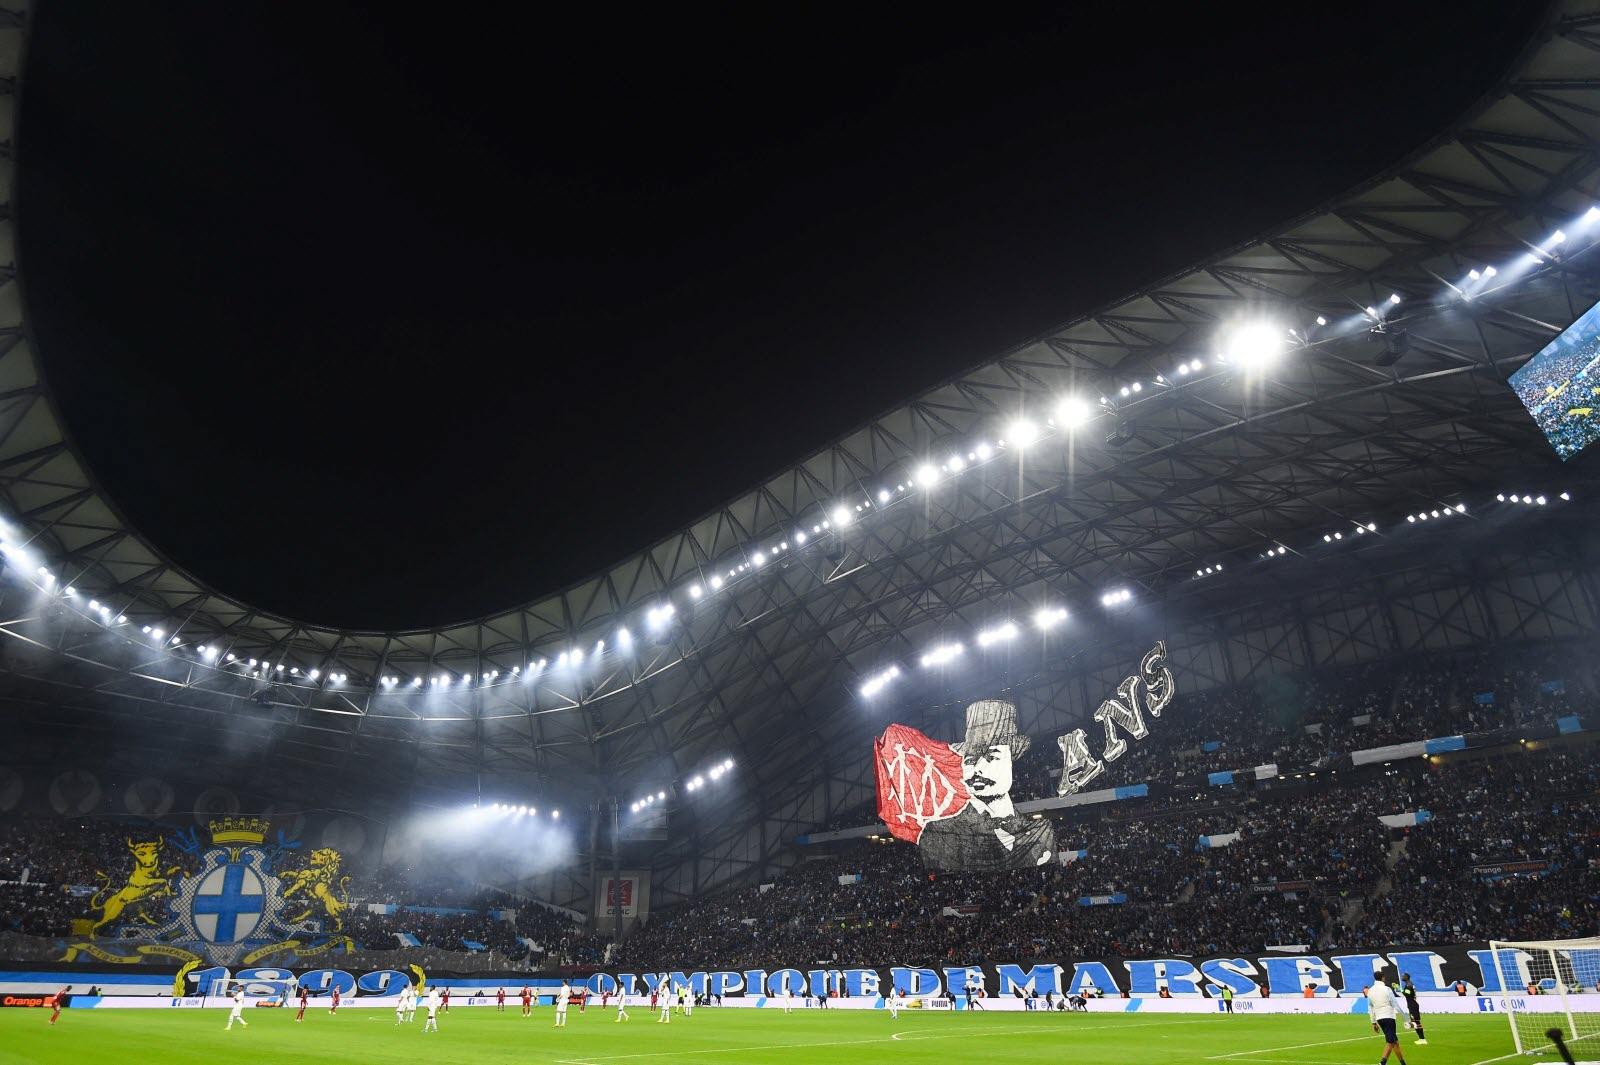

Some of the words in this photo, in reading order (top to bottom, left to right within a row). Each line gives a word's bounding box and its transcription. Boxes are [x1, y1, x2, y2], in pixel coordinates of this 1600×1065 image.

[1056, 639, 1176, 799] ANS
[188, 966, 413, 998] 1899
[586, 967, 881, 998] OLYMPIQUE
[889, 965, 987, 998] DE
[3, 996, 43, 1007] Orange
[1234, 1000, 1254, 1010] @OM
